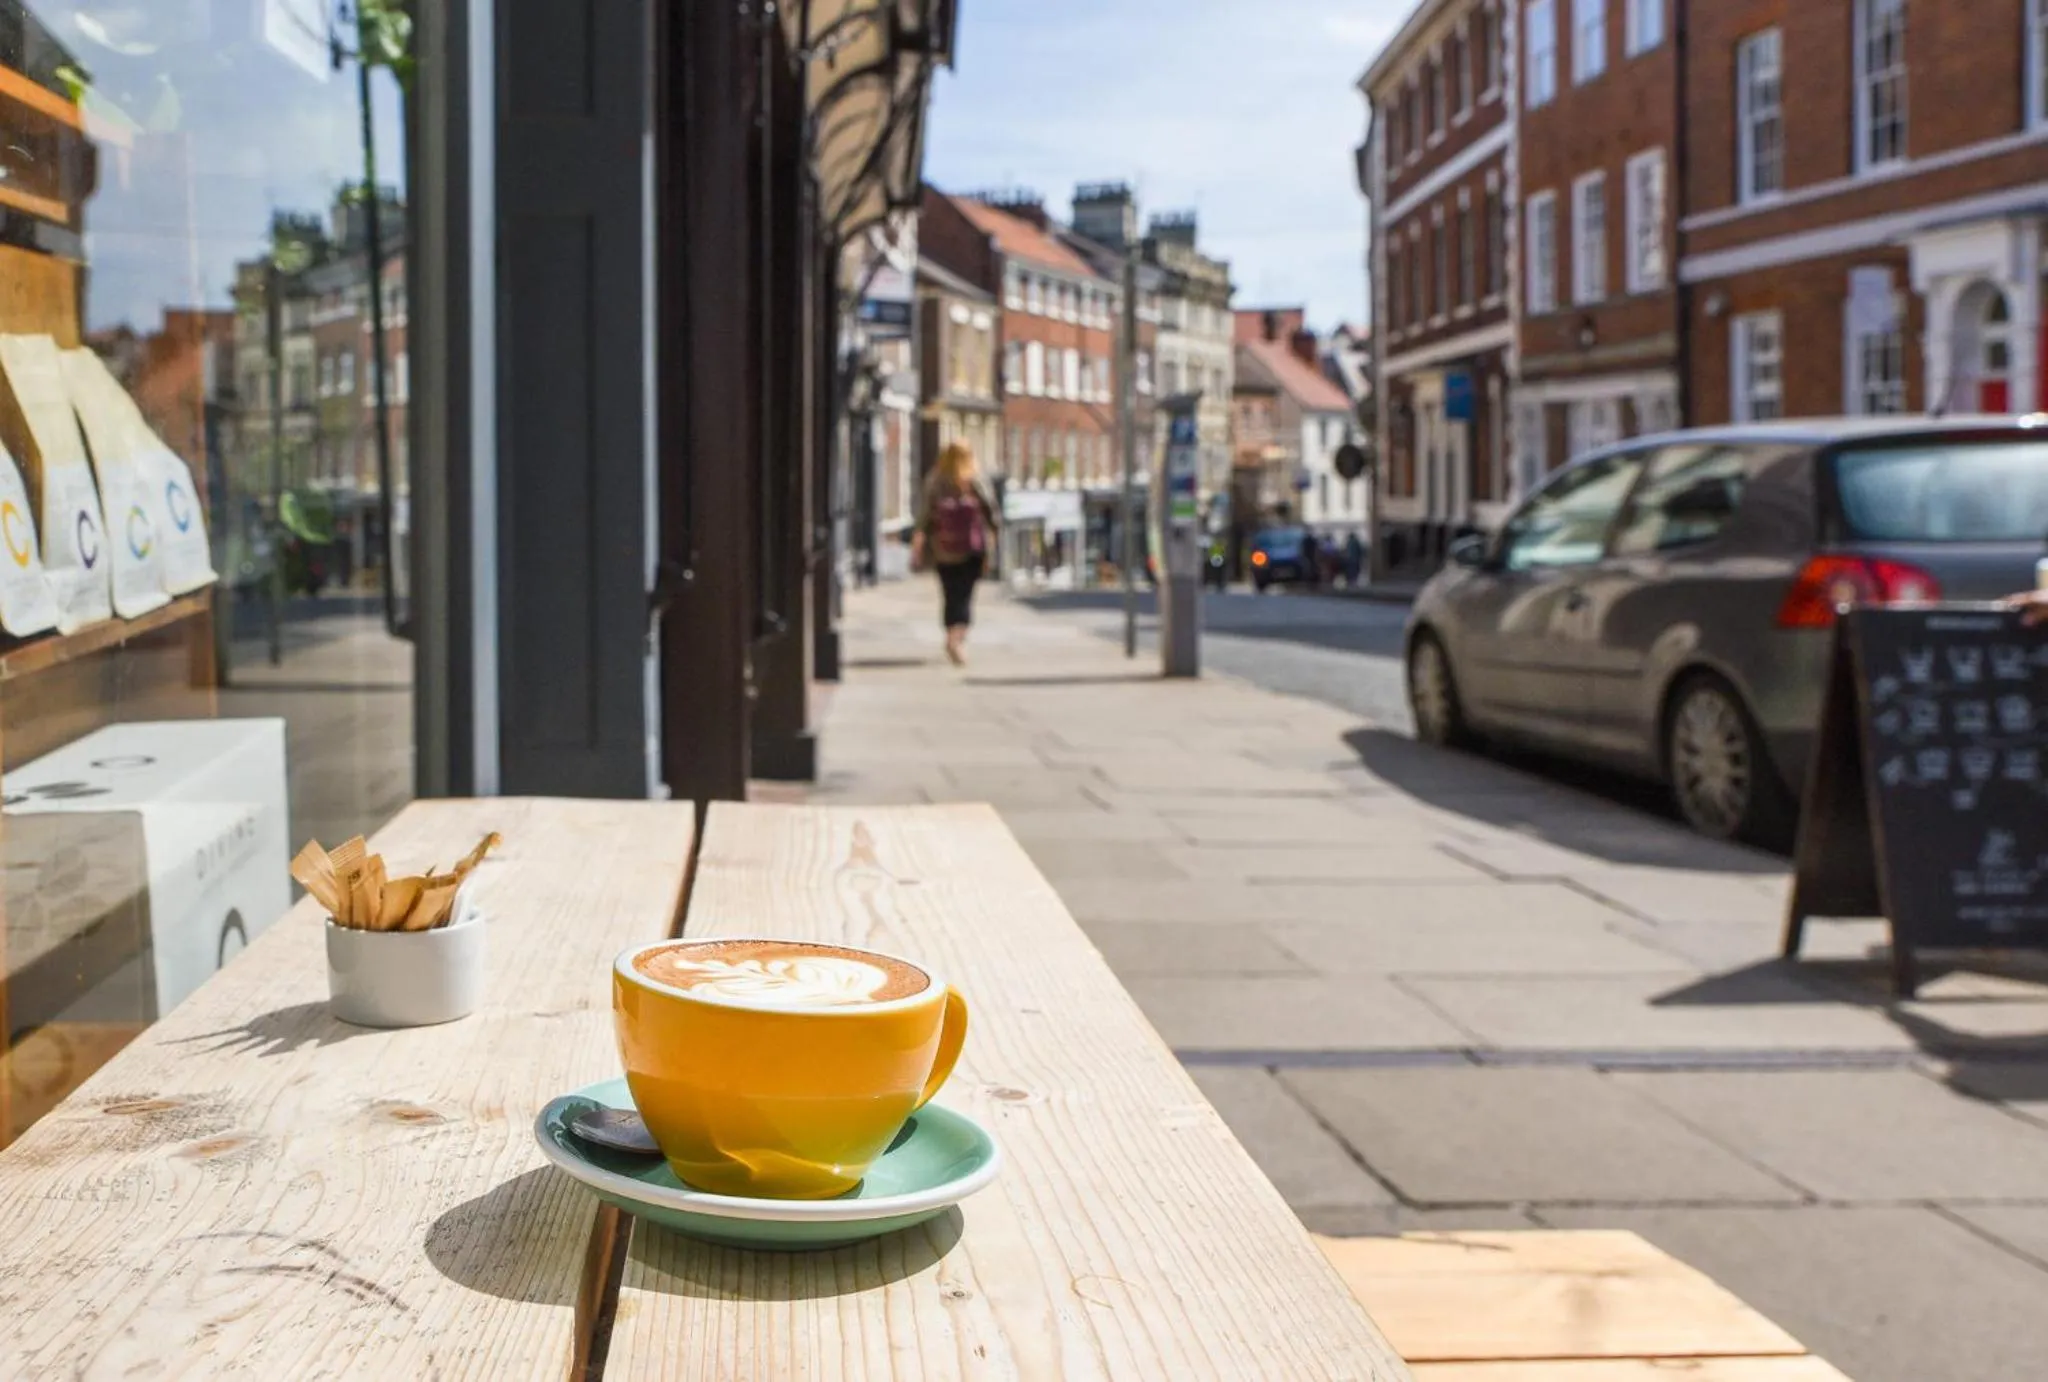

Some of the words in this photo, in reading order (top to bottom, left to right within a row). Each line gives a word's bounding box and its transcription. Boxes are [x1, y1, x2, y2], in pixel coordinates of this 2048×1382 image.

[128, 507, 153, 559] C
[166, 481, 190, 532] C
[2, 501, 31, 568] C
[77, 511, 98, 569] C
